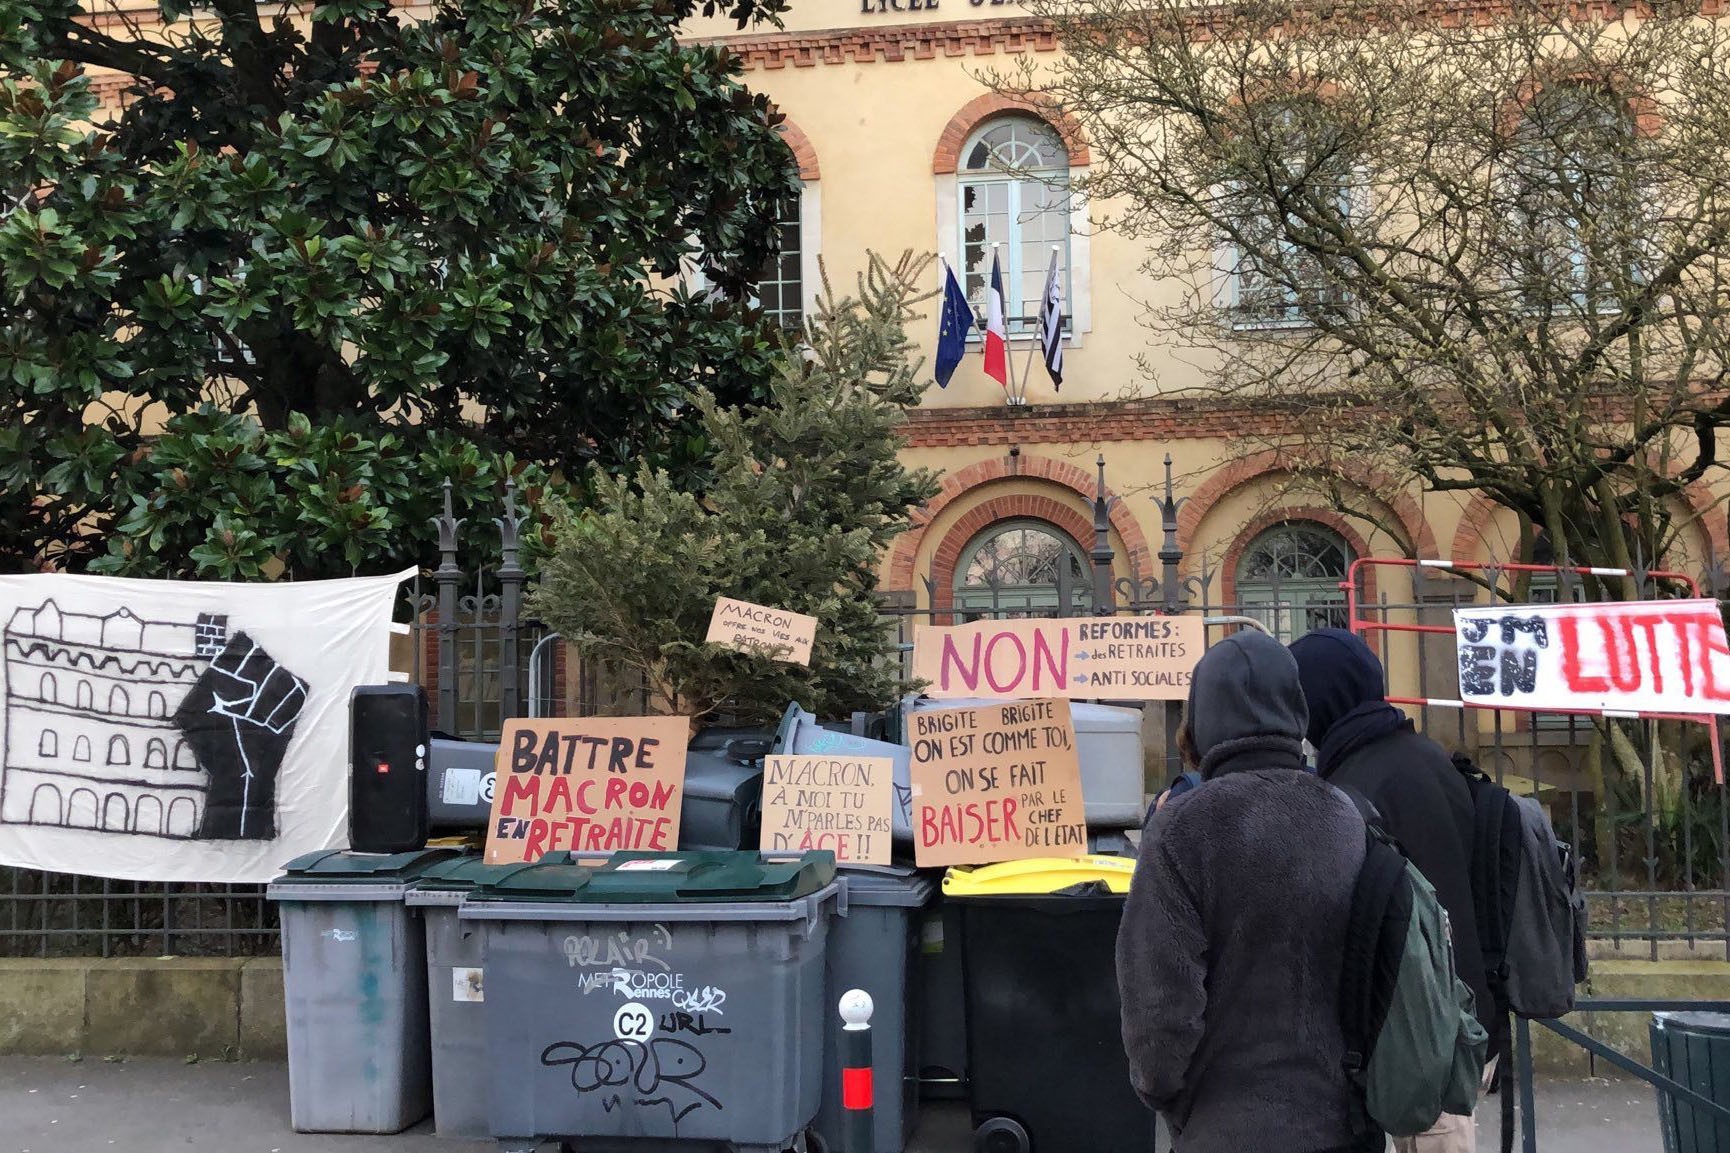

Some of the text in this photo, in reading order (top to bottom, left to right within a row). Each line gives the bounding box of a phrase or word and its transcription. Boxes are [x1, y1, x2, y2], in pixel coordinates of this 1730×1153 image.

[720, 604, 792, 629] MACRON
[772, 630, 790, 641] VIES
[941, 628, 1069, 693] NON
[1091, 642, 1186, 660] des RETRAITES
[1559, 613, 1730, 701] LUTTE
[1460, 645, 1537, 697] EN
[512, 729, 660, 776] BATTRE
[914, 739, 943, 763] ON
[950, 735, 975, 757] EST
[983, 728, 1037, 754] COMME
[946, 767, 974, 794] ON
[978, 766, 999, 791] SE
[501, 775, 675, 816] MACRON
[770, 786, 865, 808] À MOI TU
[1021, 789, 1067, 808] PAR LE
[496, 817, 530, 839] EN
[867, 816, 890, 832] PAS
[1028, 809, 1062, 824] CHEF
[1025, 827, 1040, 847] DE
[618, 1012, 648, 1036] C2
